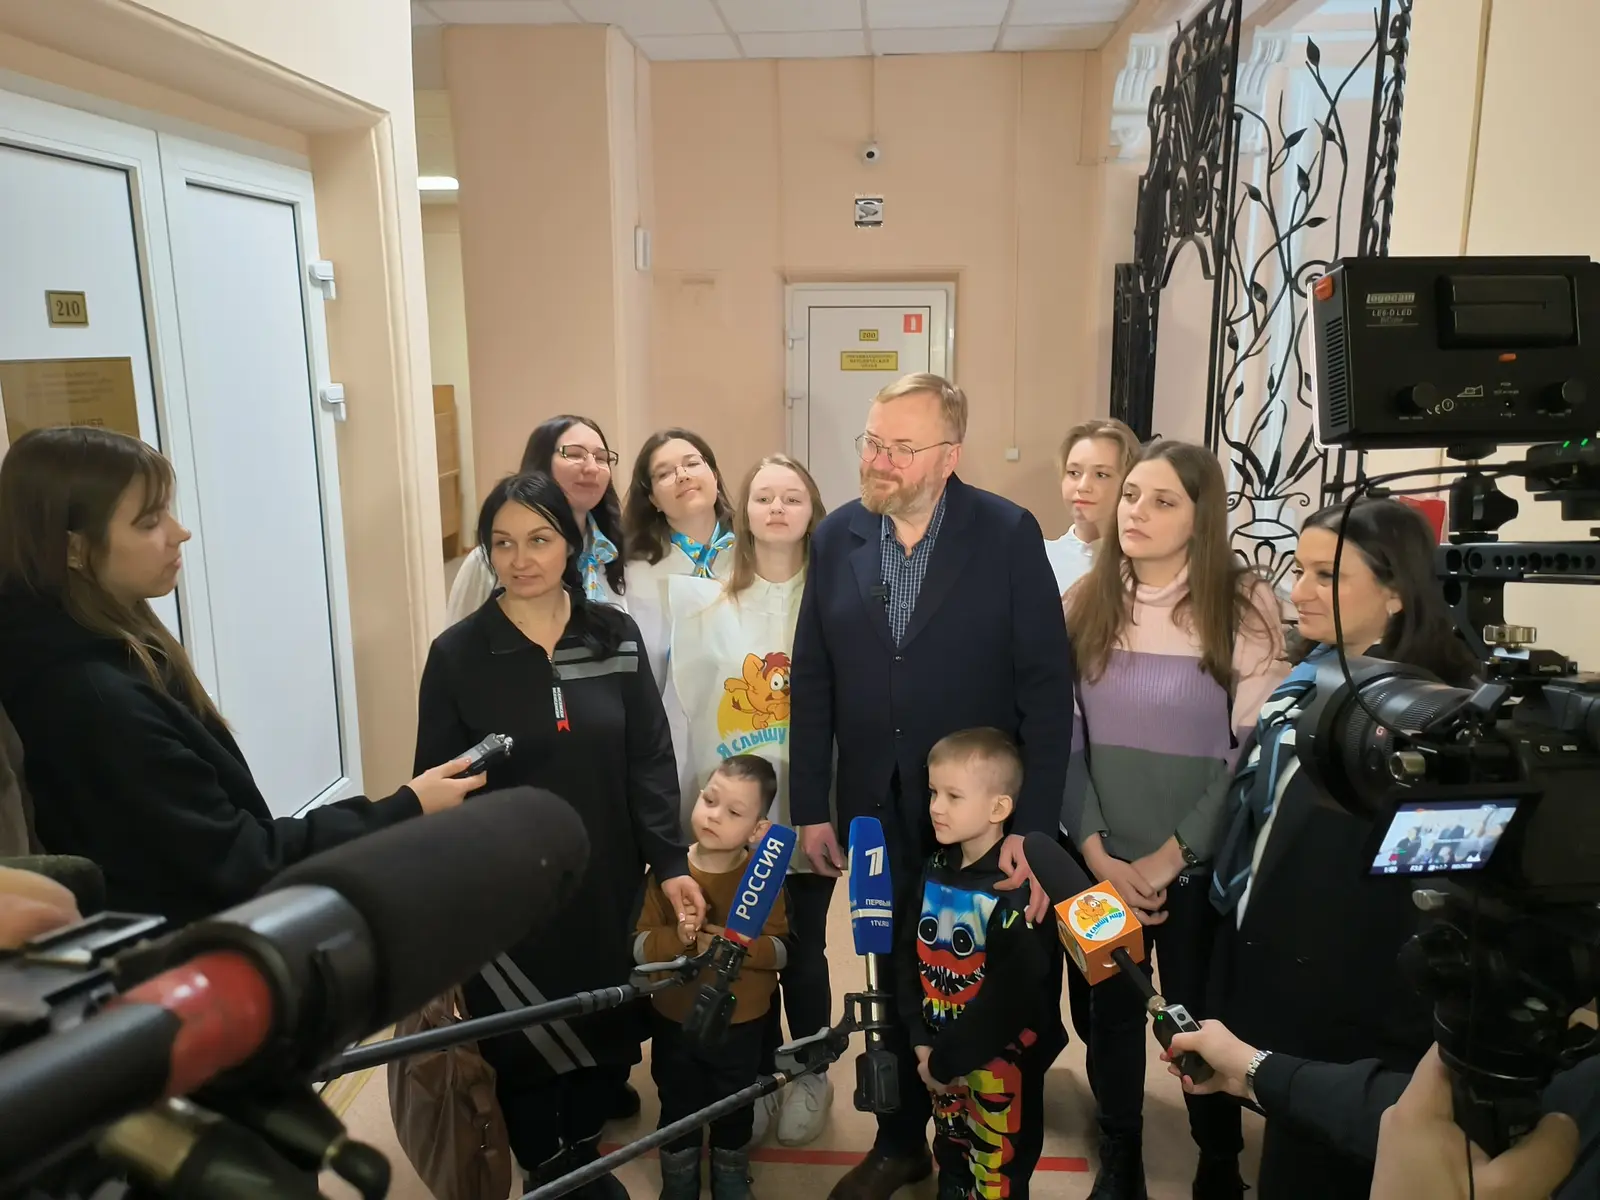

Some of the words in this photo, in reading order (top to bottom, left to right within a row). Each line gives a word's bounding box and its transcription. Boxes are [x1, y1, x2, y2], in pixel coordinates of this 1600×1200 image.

[56, 299, 80, 317] 210
[716, 742, 732, 760] Я
[865, 846, 884, 876] 1
[736, 837, 785, 920] РОССИЯ
[865, 898, 891, 907] ПЕРВЫЙ
